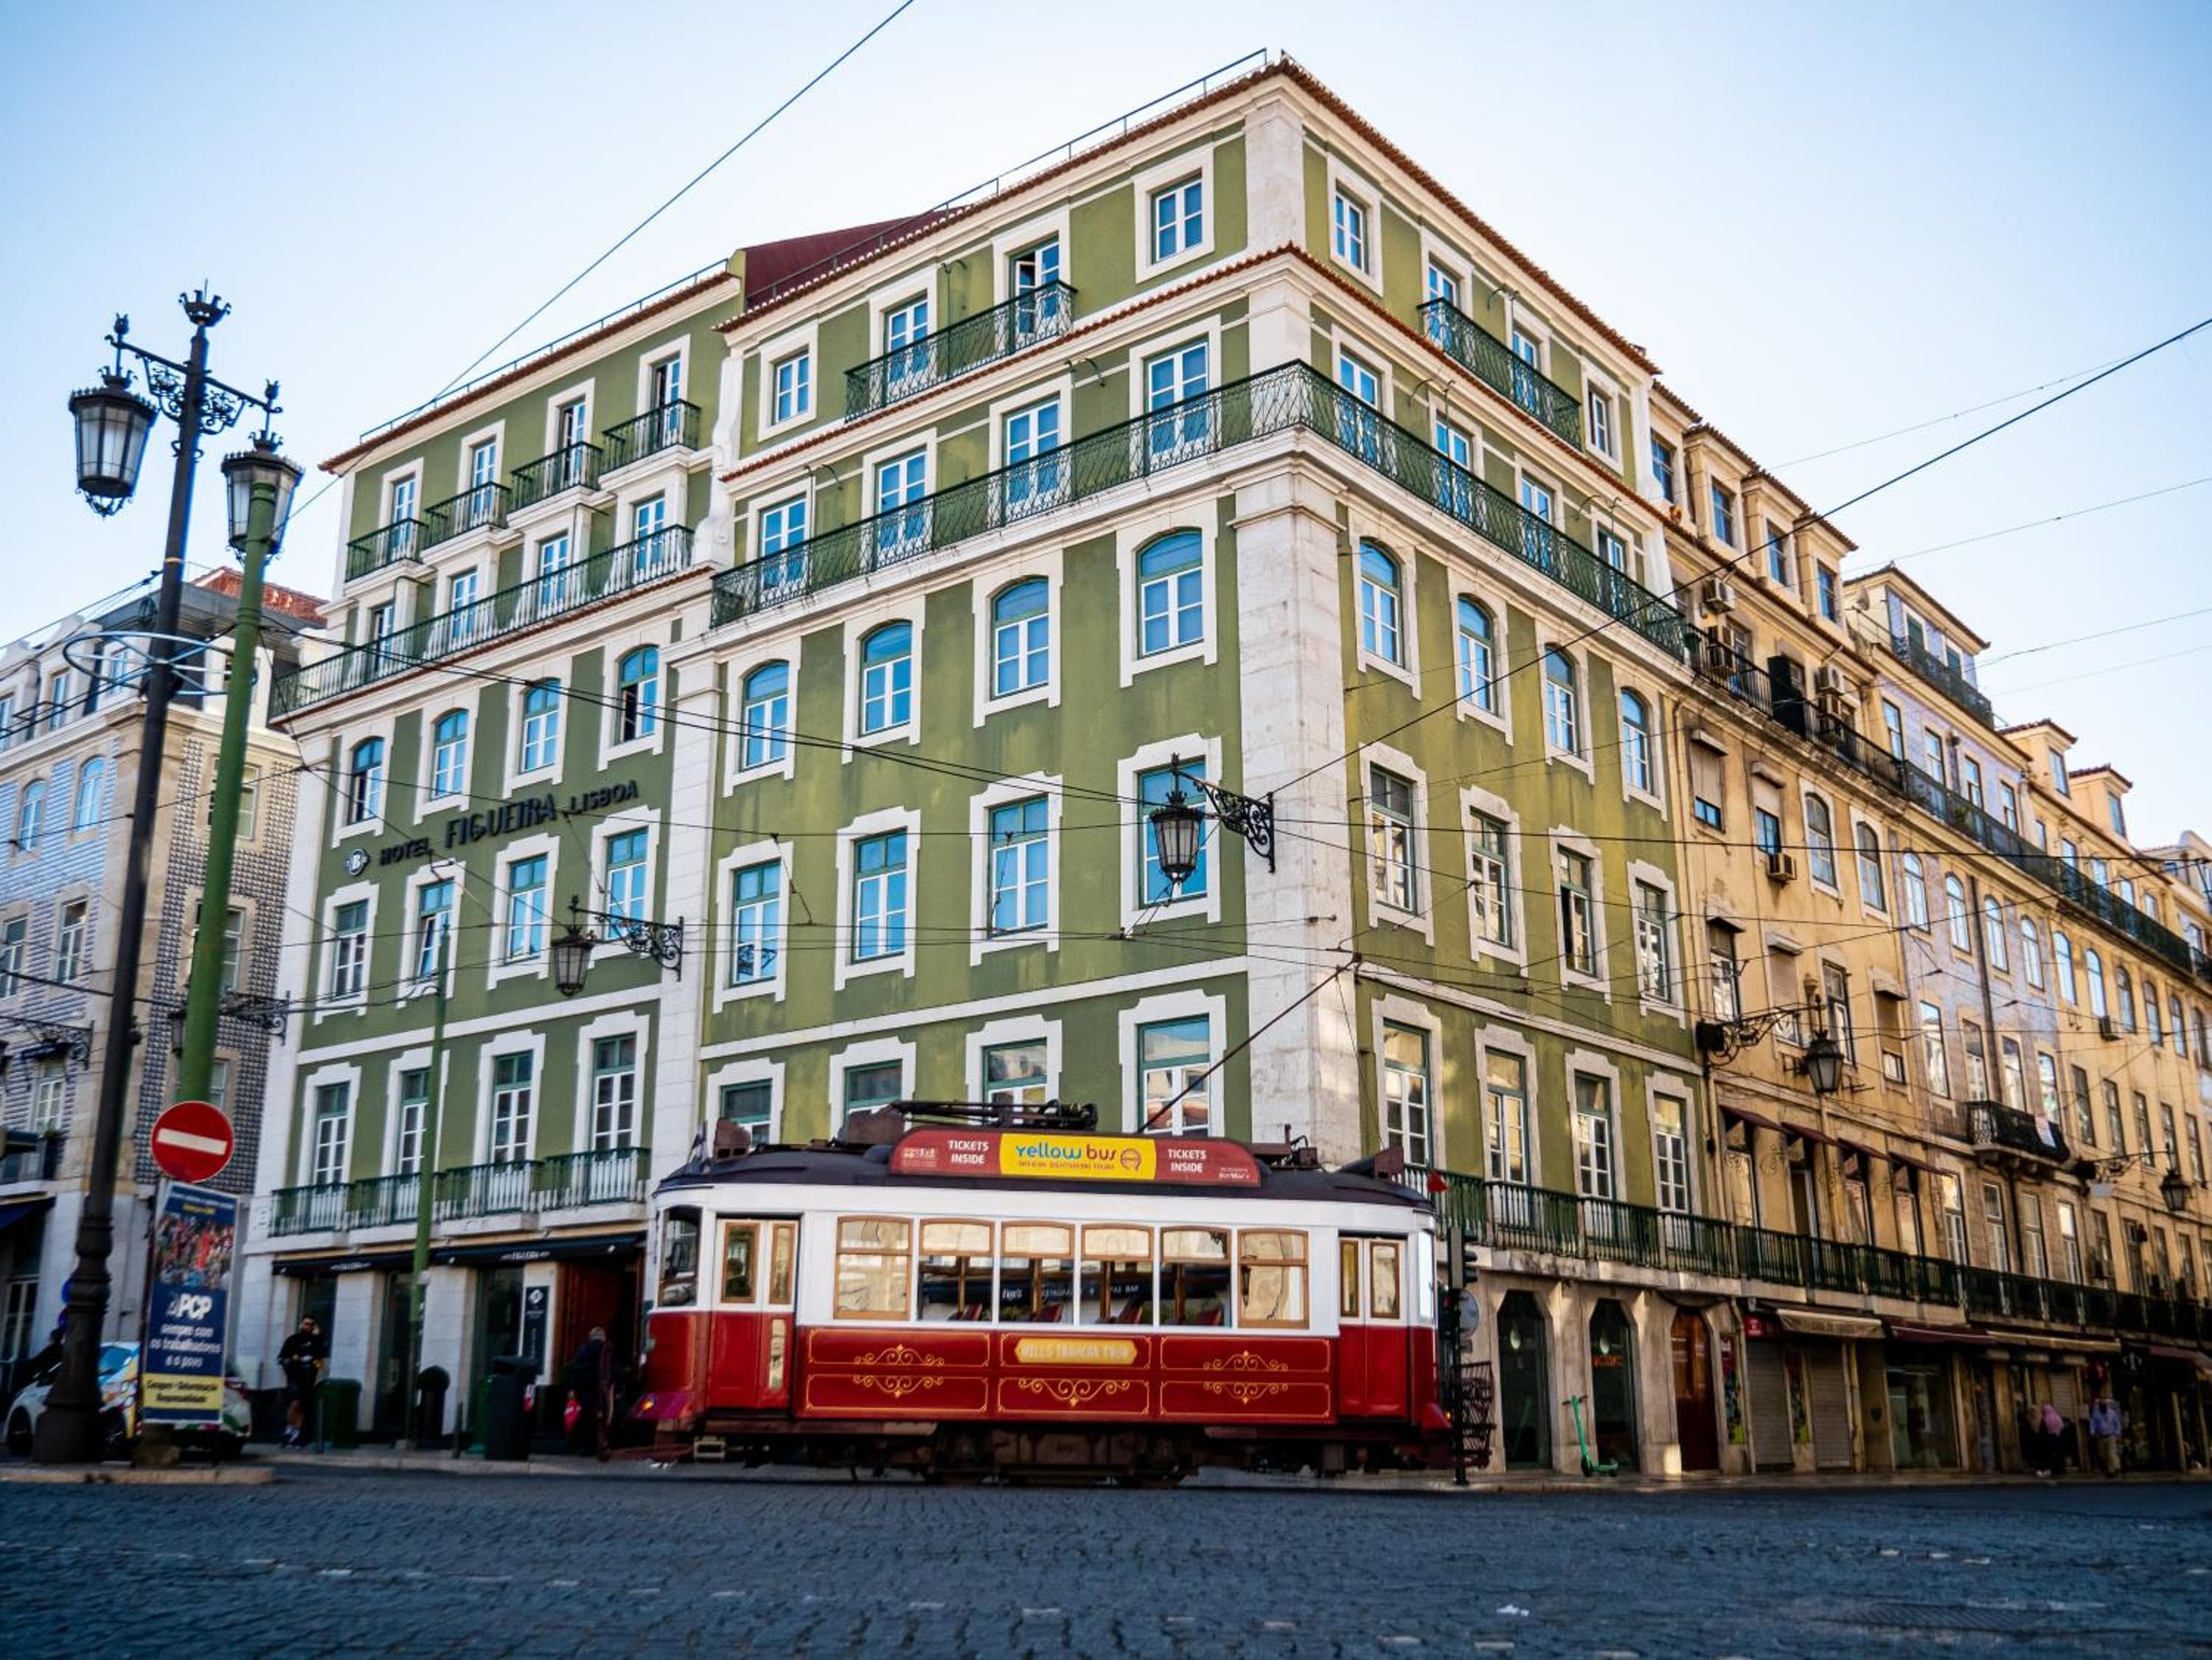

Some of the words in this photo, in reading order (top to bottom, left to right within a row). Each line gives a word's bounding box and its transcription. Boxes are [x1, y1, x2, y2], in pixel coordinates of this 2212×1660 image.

[379, 837, 432, 866] HOTEL
[445, 794, 557, 848] FIGUEIRA
[568, 781, 639, 815] LISBOA
[947, 1140, 989, 1151] TICKETS
[1086, 1143, 1117, 1161] bus
[1168, 1148, 1207, 1159] TICKETS
[951, 1153, 985, 1165] INSIDE
[1171, 1162, 1203, 1173] INSIDE
[178, 1292, 212, 1321] PCP
